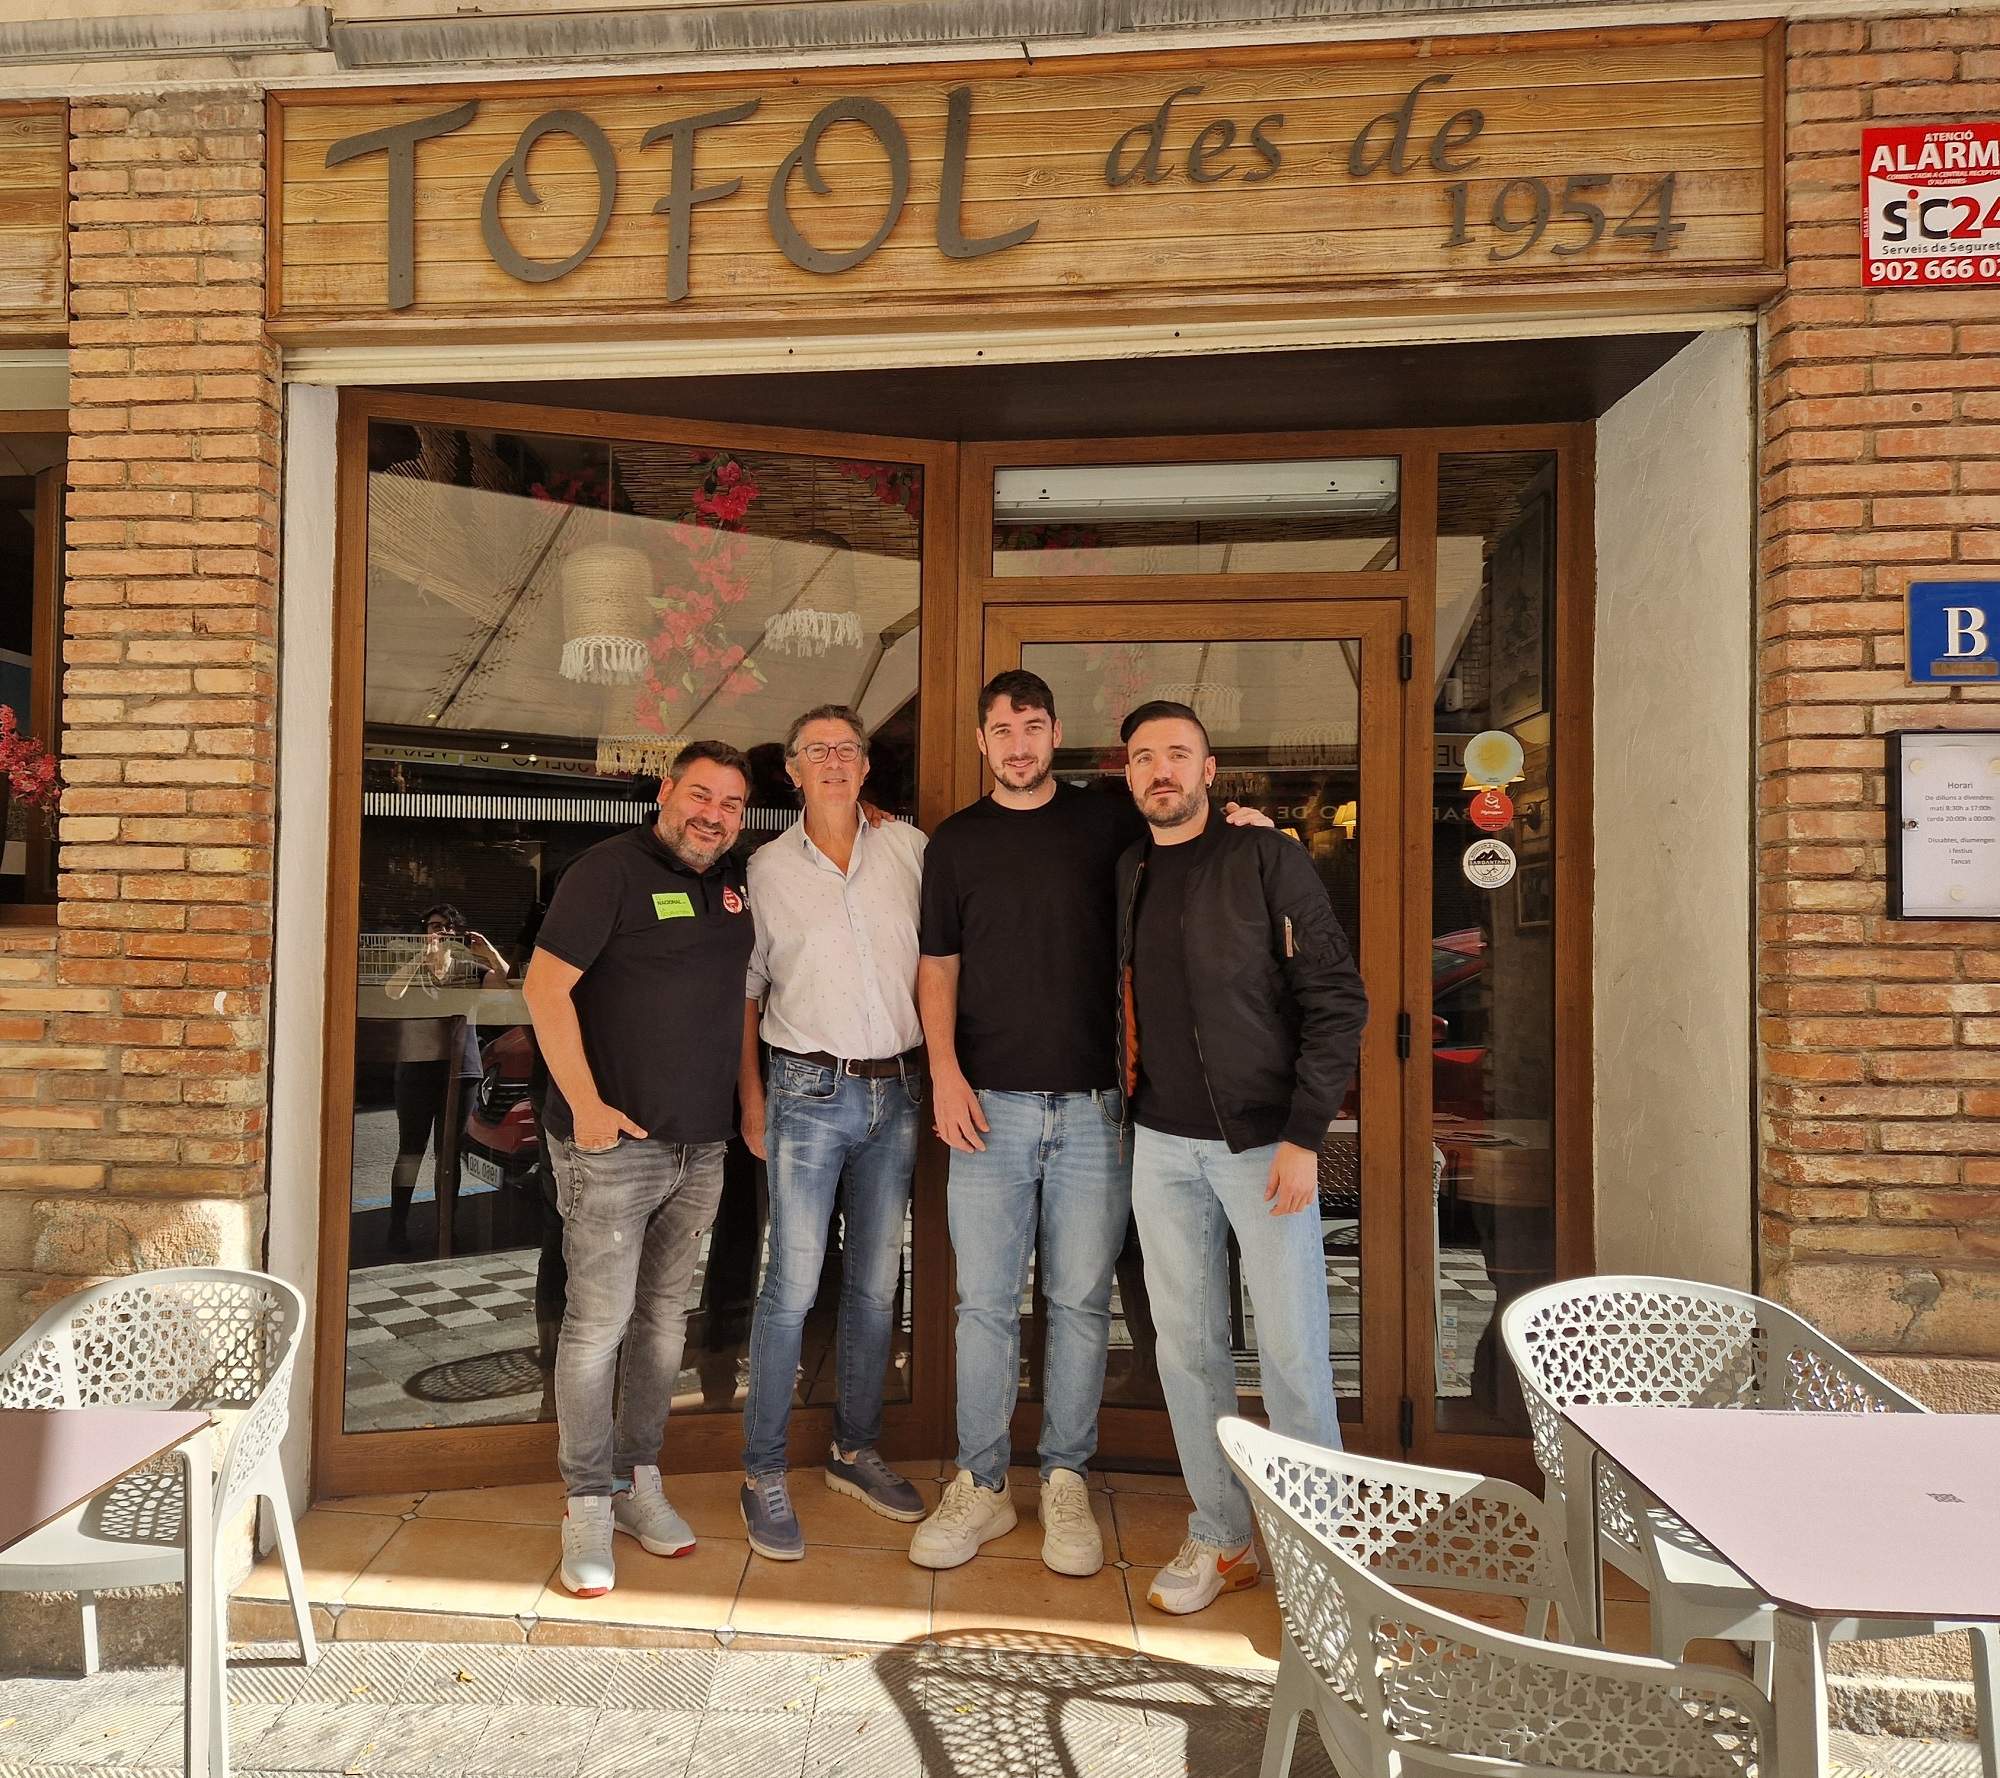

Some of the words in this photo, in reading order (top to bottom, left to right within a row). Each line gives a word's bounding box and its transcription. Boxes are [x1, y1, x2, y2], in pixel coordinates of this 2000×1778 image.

[1924, 130, 1974, 142] ATENCIÓ
[325, 86, 1039, 309] TOFOL
[1105, 86, 1284, 186] des
[1349, 74, 1485, 176] de
[1440, 171, 1686, 260] 1954
[1882, 244, 1928, 255] Serveis
[1931, 243, 1947, 253] de
[1870, 260, 1919, 282] 902
[1924, 258, 1975, 280] 666
[1943, 607, 1988, 658] B
